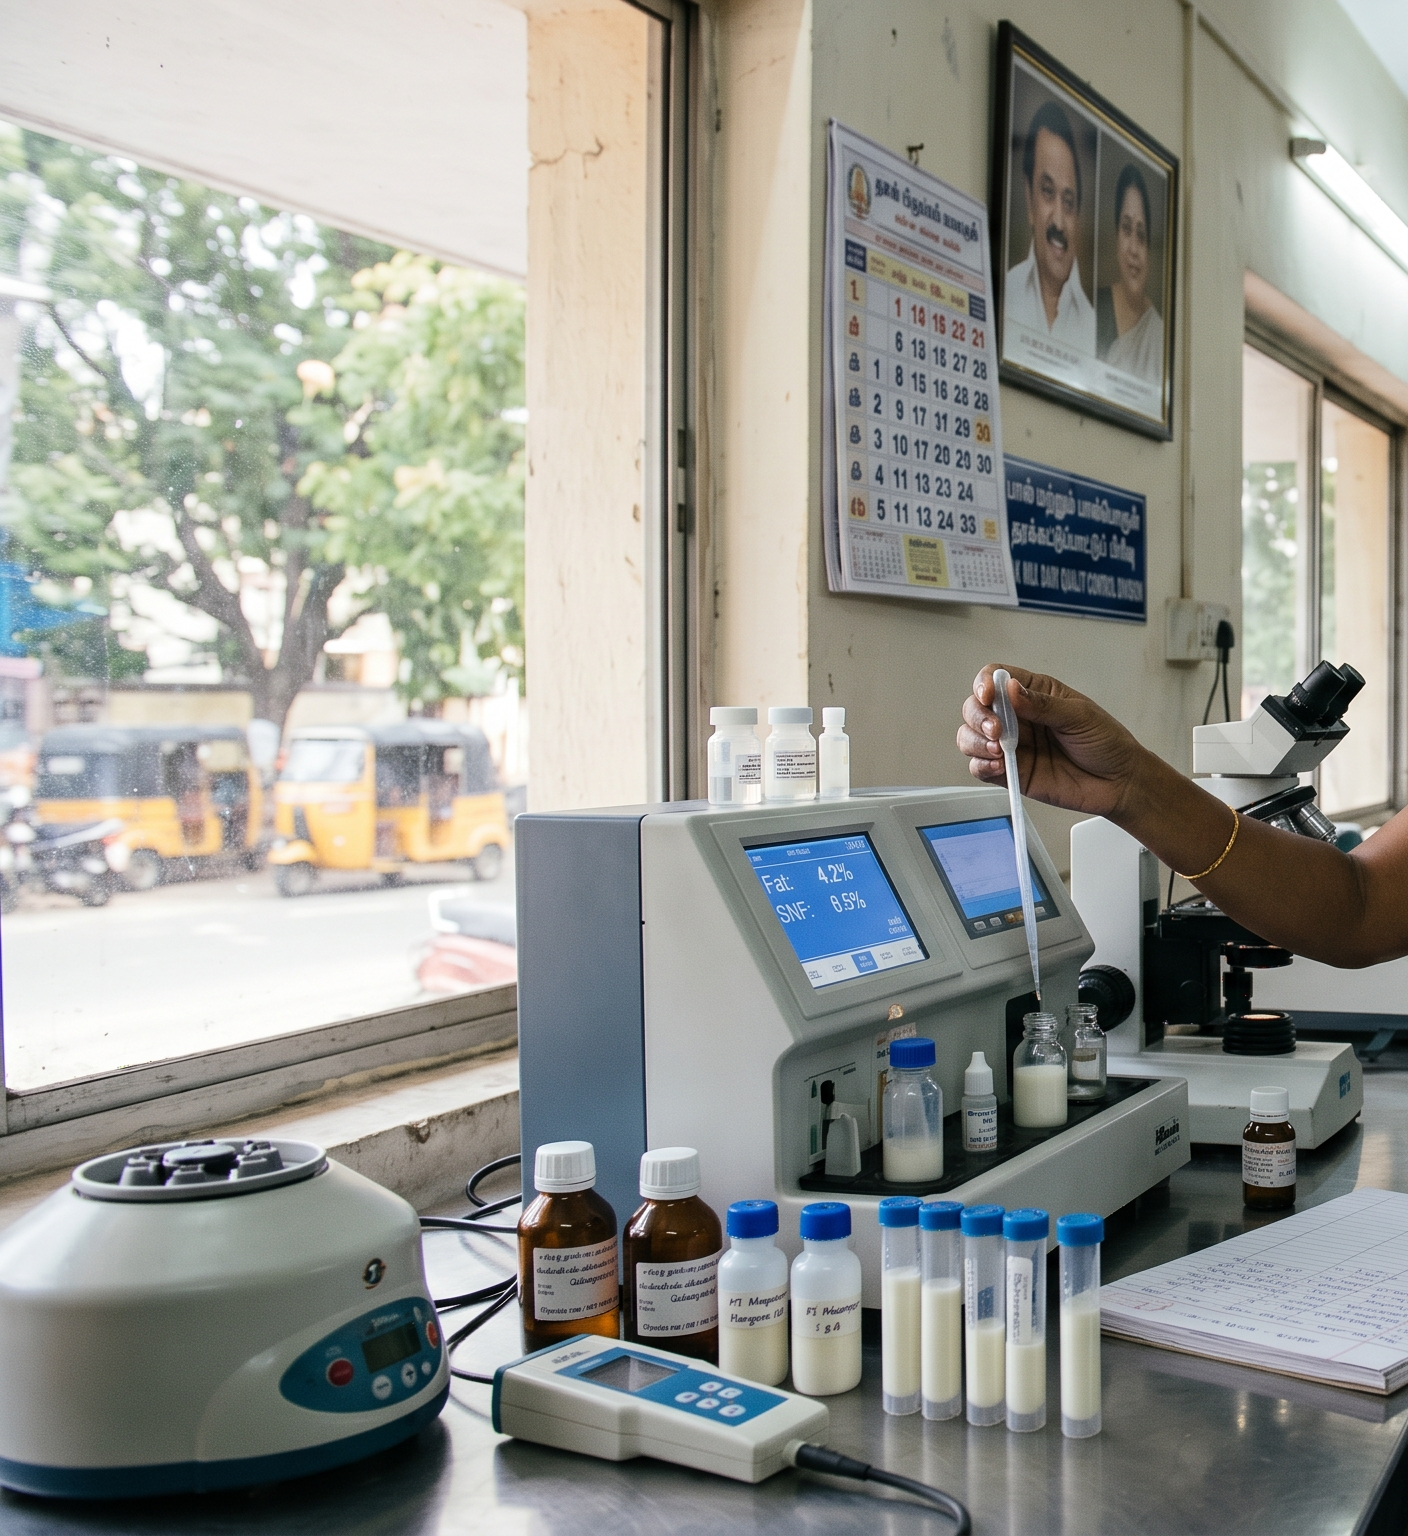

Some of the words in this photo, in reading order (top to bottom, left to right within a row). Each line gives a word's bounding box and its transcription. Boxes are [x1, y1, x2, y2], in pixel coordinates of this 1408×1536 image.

[873, 358, 880, 380] 1
[895, 364, 903, 387] 8
[911, 371, 926, 394] 15
[954, 384, 969, 407] 28
[974, 390, 989, 412] 28
[953, 352, 968, 374] 27
[973, 359, 987, 381] 28
[873, 393, 882, 415] 2
[896, 399, 904, 421] 9
[912, 404, 927, 427] 17
[955, 416, 970, 438] 29
[874, 427, 882, 450] 3
[893, 433, 908, 456] 10
[914, 438, 928, 461] 17
[977, 453, 992, 475] 30
[875, 464, 884, 486] 4
[893, 467, 907, 490] 11
[915, 472, 930, 495] 13
[935, 476, 951, 499] 23
[958, 481, 973, 502] 24
[1006, 476, 1035, 505] பால்
[877, 498, 886, 521] 5
[894, 501, 908, 525] 11
[937, 509, 954, 531] 24
[960, 513, 976, 535] 33
[761, 874, 794, 895] Fat:
[776, 901, 815, 924] SNF:
